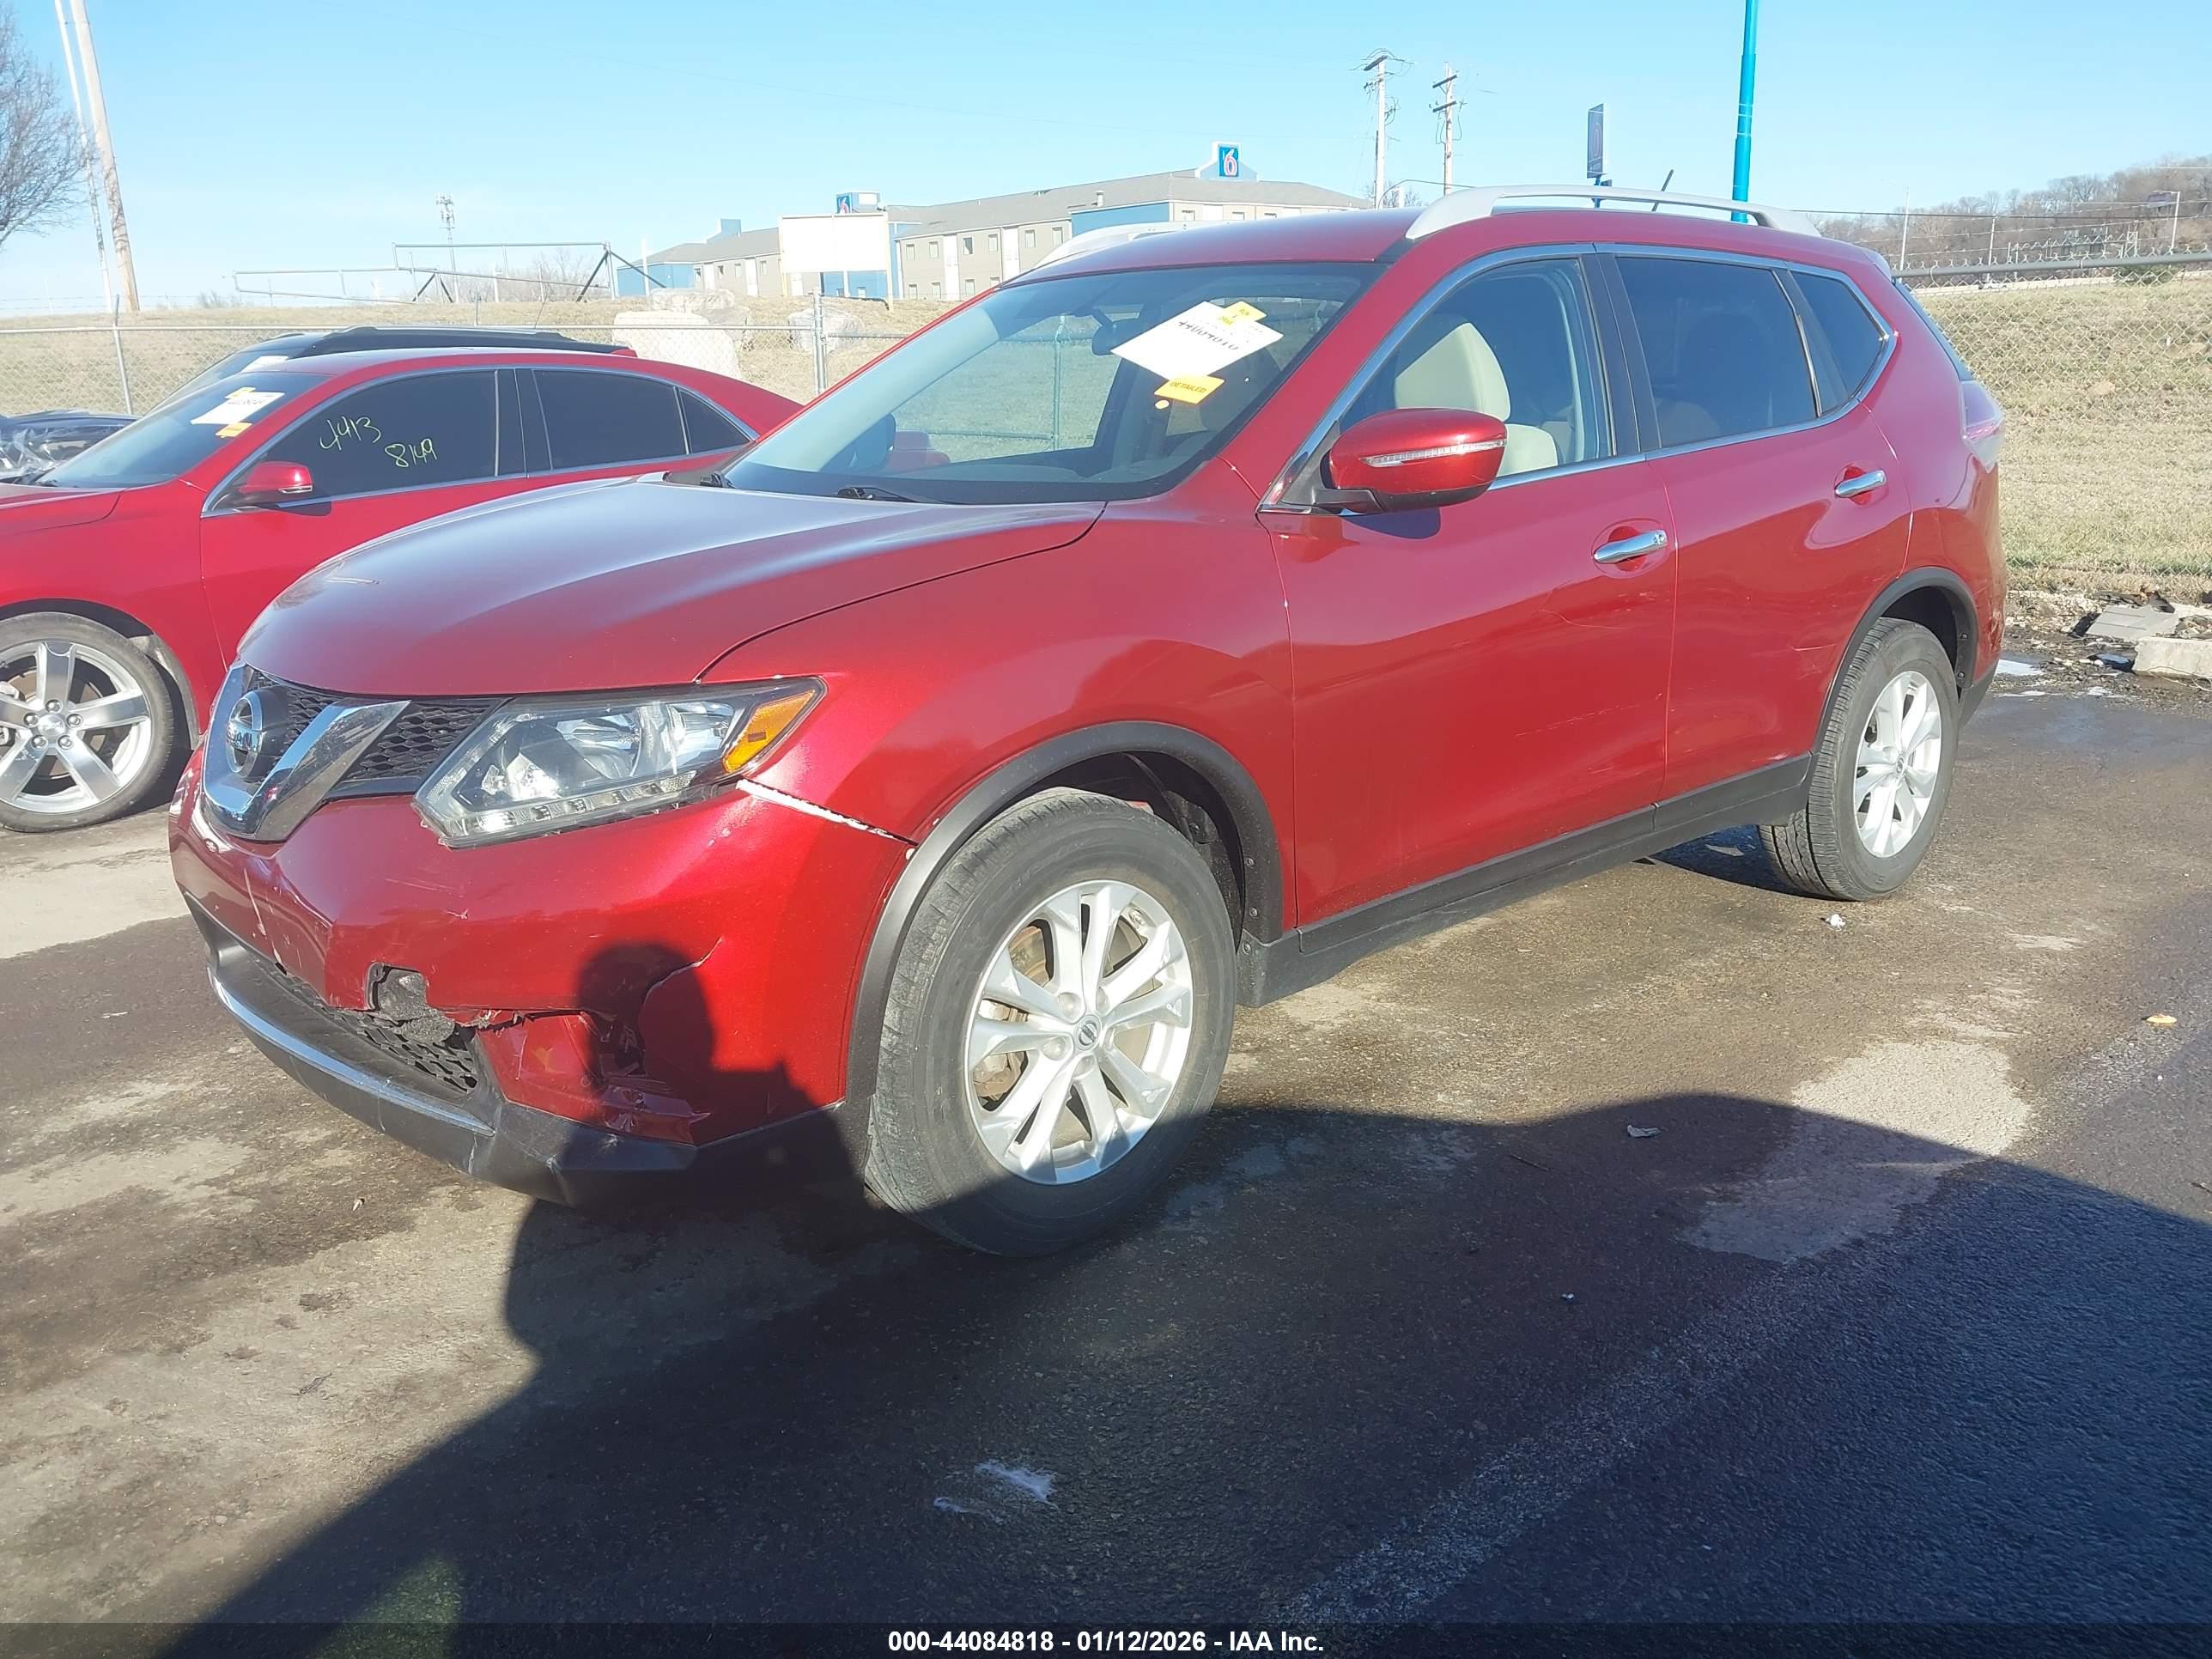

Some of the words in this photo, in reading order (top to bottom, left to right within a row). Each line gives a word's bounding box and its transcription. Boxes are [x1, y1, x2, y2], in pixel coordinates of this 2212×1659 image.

[1224, 148, 1237, 176] 6
[1170, 381, 1207, 393] DETAILED
[319, 416, 381, 451] 4413
[384, 438, 437, 467] 8149
